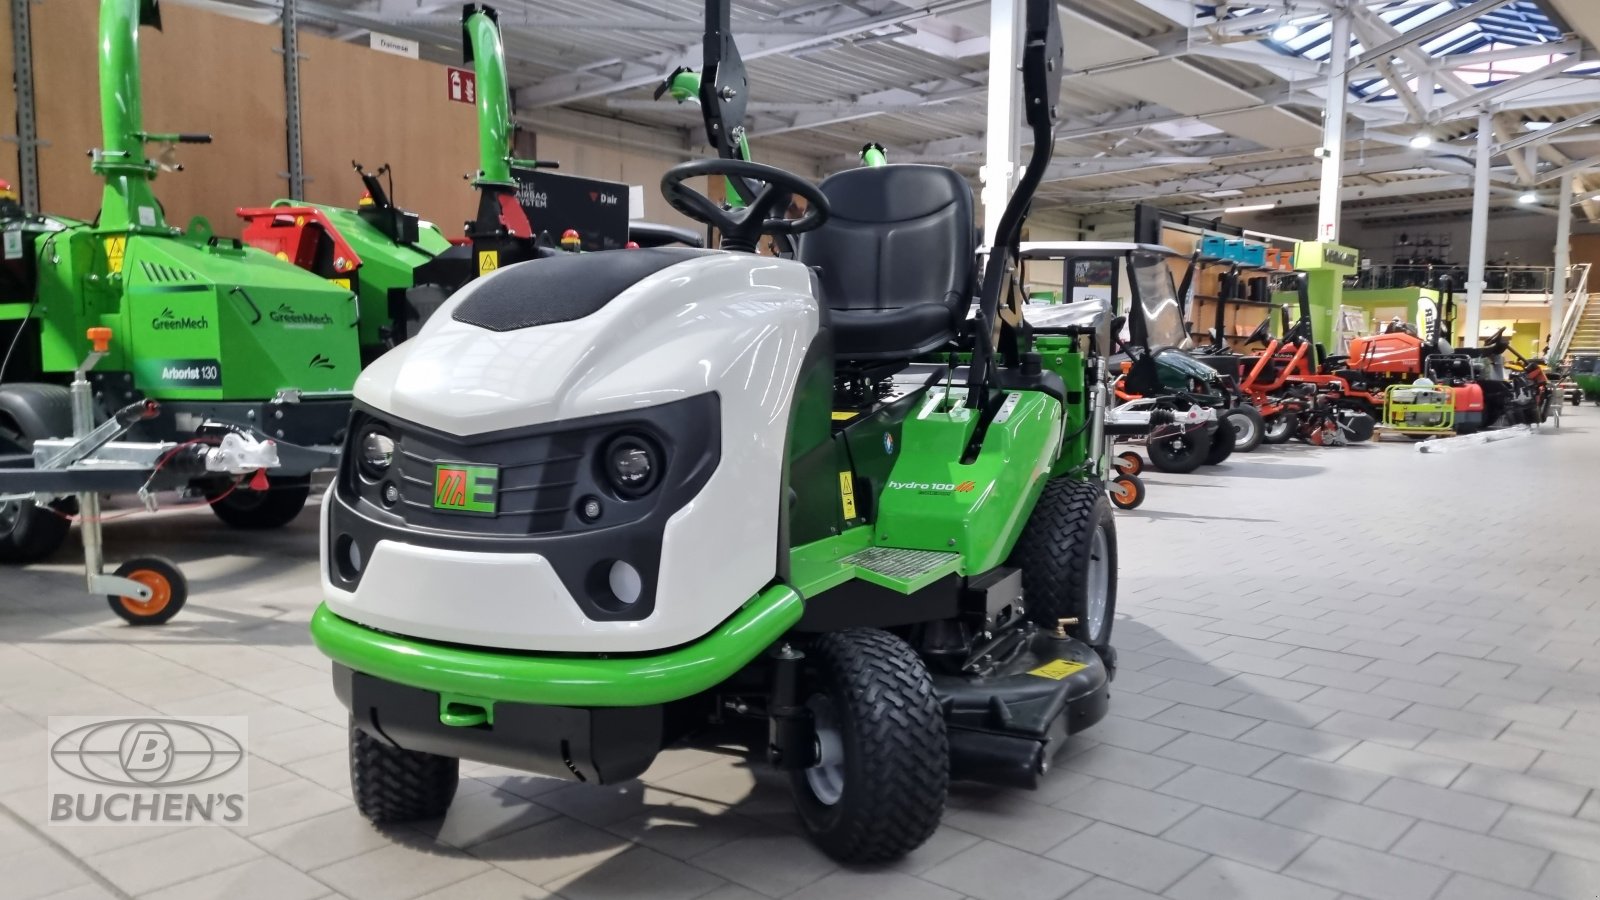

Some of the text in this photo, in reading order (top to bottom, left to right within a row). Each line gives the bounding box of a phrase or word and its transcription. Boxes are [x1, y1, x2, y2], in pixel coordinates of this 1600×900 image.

[514, 190, 548, 201] AIRBAG
[152, 316, 209, 331] GreenMech
[269, 310, 334, 325] GreenMech
[162, 366, 217, 380] Arborist 130
[888, 480, 956, 491] hydro 100
